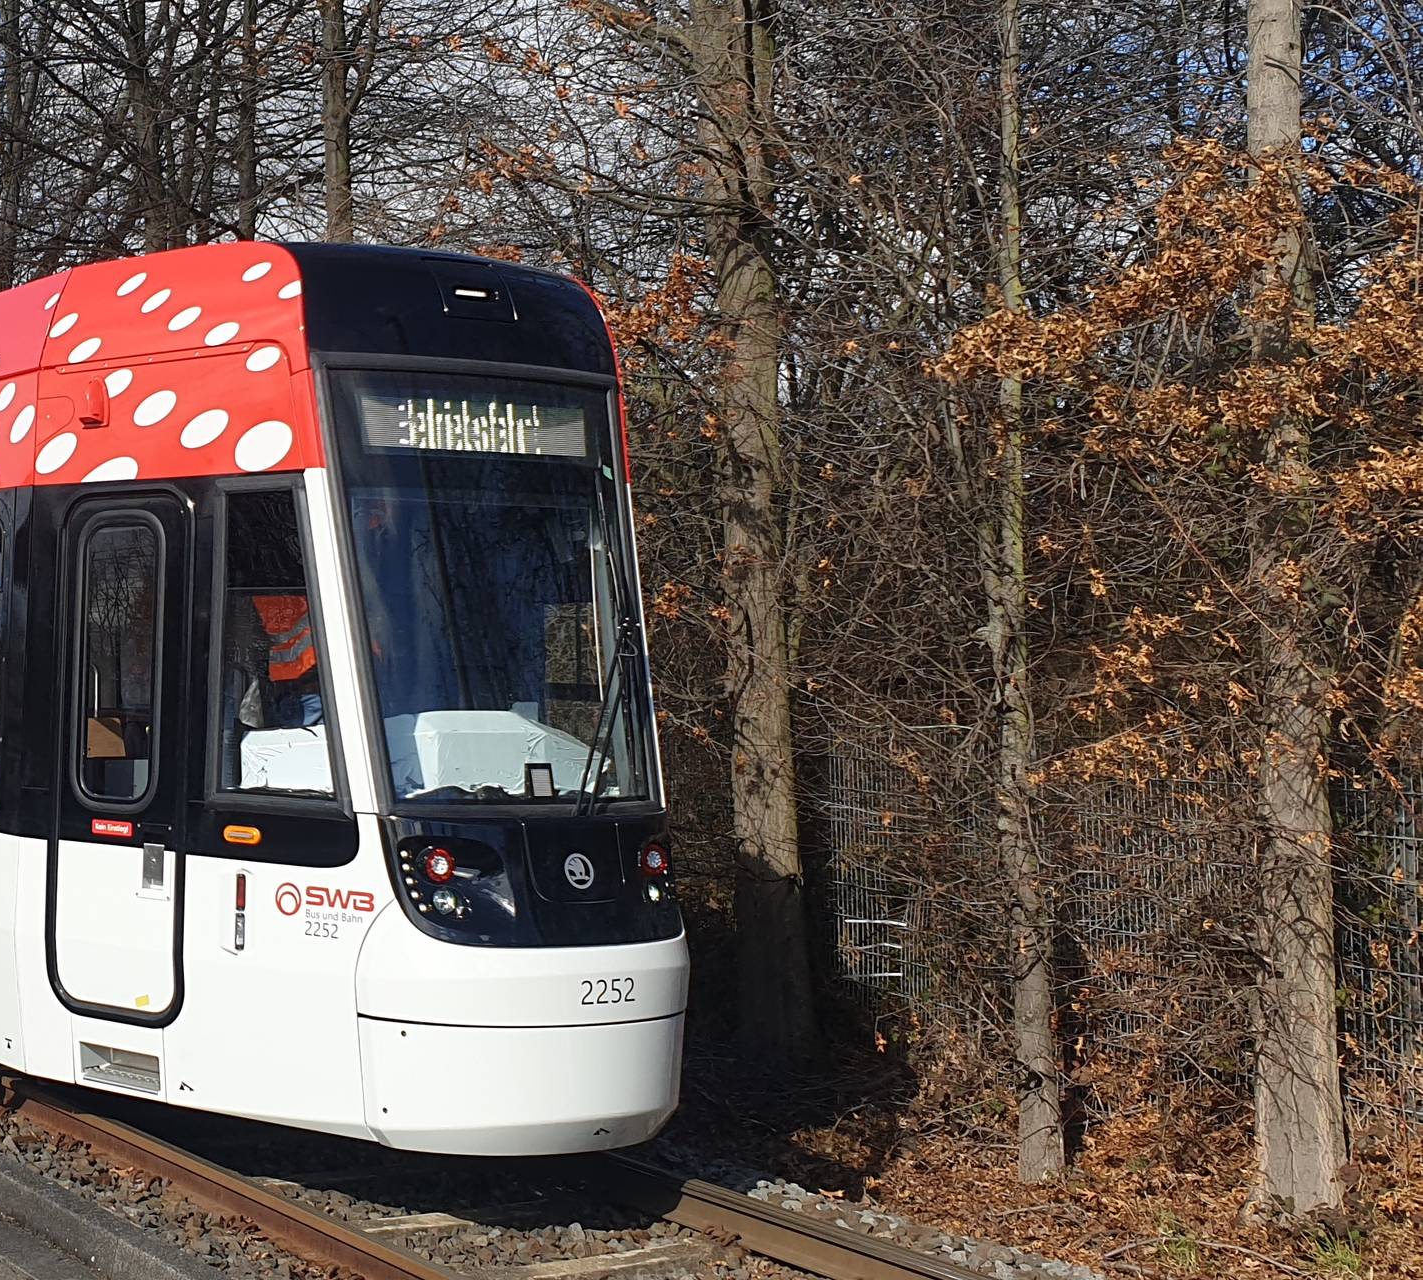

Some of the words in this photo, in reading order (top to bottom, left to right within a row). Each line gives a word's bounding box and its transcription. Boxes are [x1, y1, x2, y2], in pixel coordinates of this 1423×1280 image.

[305, 886, 375, 912] SWB
[305, 909, 320, 919] Bus
[322, 911, 338, 922] und
[341, 913, 363, 924] Bahn
[305, 921, 339, 939] 2252
[581, 977, 636, 1005] 2252
